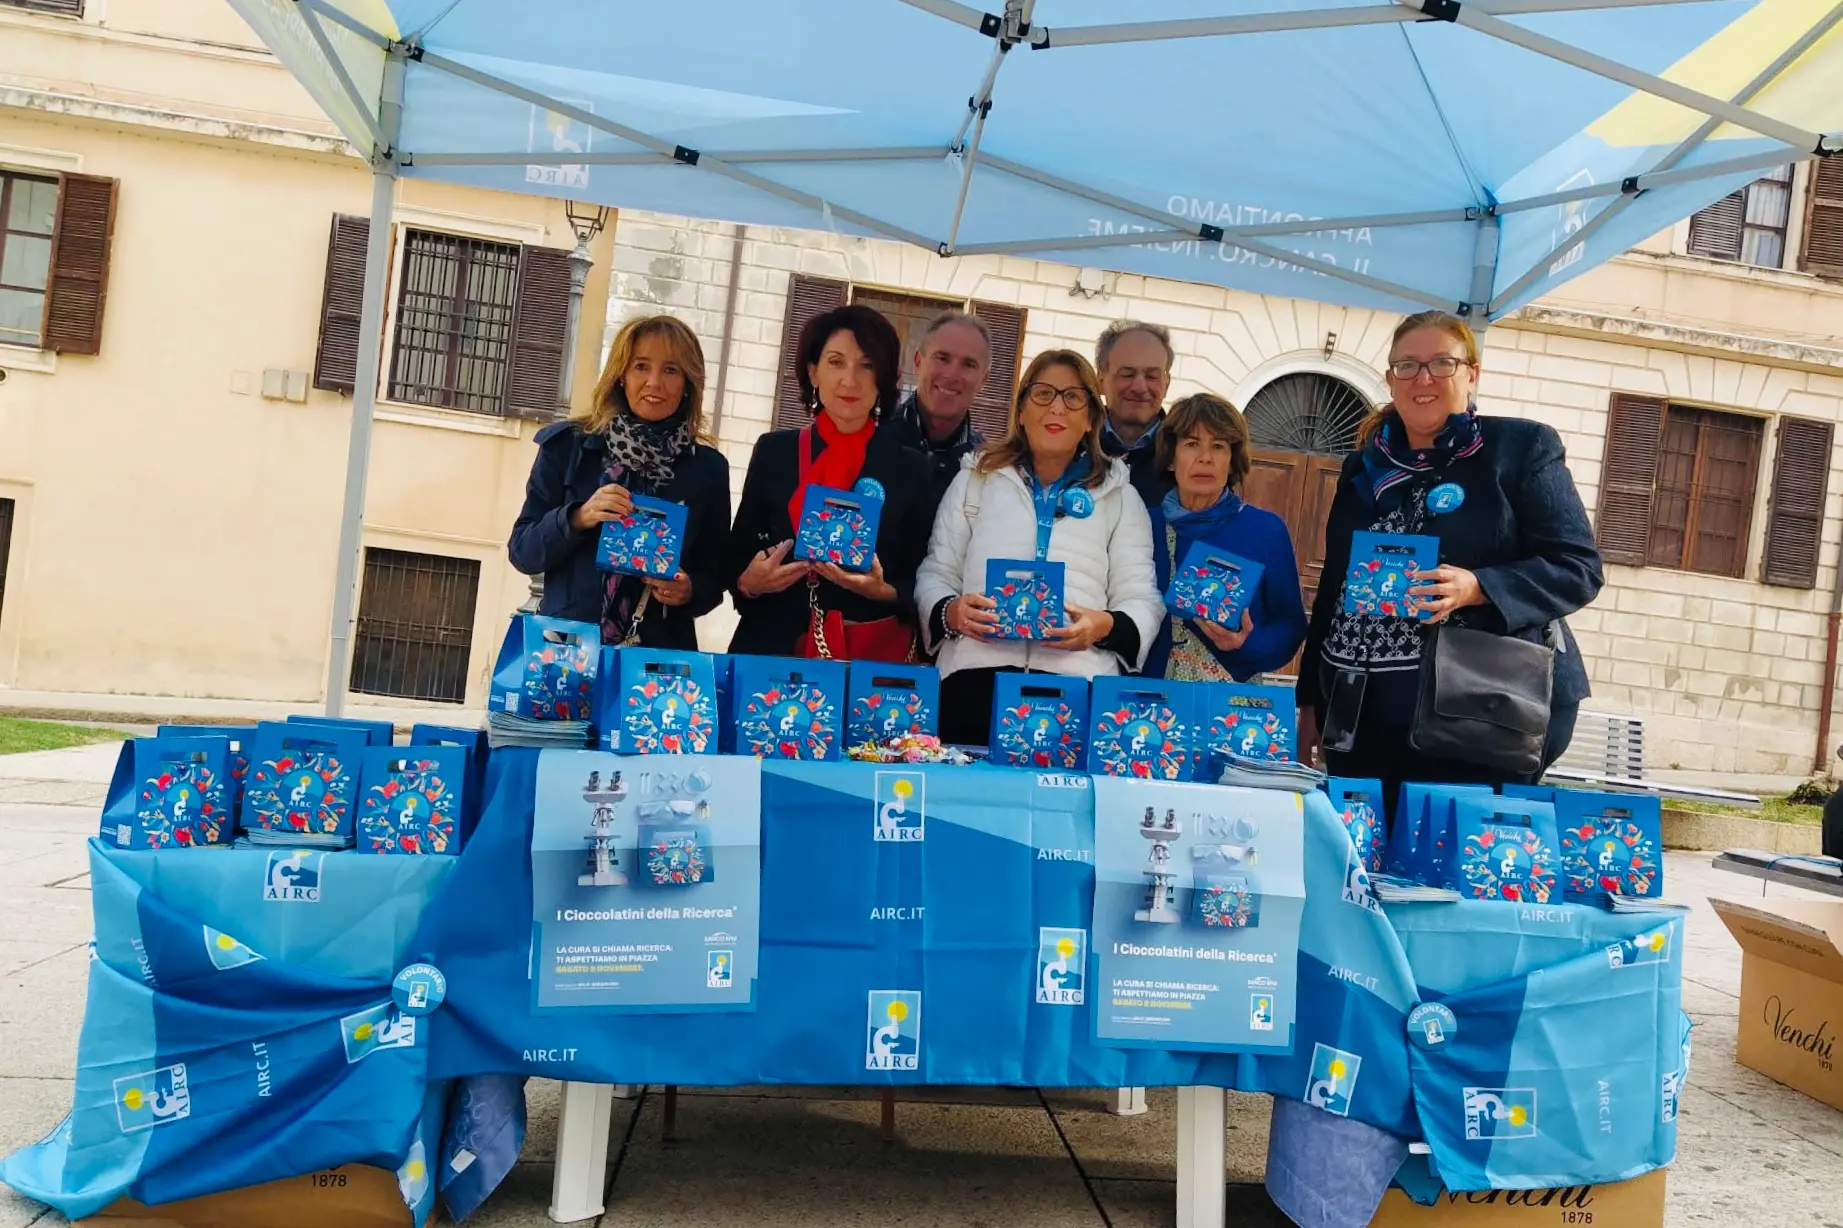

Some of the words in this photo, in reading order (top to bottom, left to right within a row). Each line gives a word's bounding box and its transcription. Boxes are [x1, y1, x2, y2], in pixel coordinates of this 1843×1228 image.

[1041, 774, 1087, 787] AIRC
[289, 800, 312, 808] AIRC
[877, 828, 922, 840] AIRC
[1037, 847, 1090, 862] AIRC.IT
[267, 887, 318, 900] AIRC
[1345, 890, 1377, 911] AIR
[557, 910, 561, 921] I
[564, 907, 644, 921] Cioccolatini
[647, 907, 680, 920] della
[870, 907, 925, 920] AIRC.IT
[1521, 908, 1575, 923] AIRC.IT
[556, 945, 567, 953] LA
[568, 945, 591, 953] CURA
[592, 945, 600, 953] SI
[602, 944, 634, 952] CHIAMA
[1114, 943, 1118, 954] I
[1120, 943, 1193, 959] Cioccolatini
[1196, 949, 1225, 961] della
[556, 956, 564, 964] TI
[565, 955, 617, 963] ASPETTIAMO
[629, 954, 658, 962] PIAZZA
[400, 966, 445, 993] VOLONTARIO
[1113, 979, 1123, 987] LA
[1124, 980, 1145, 988] CURA
[1154, 981, 1185, 989] CHIAMA
[1328, 965, 1379, 989] AIRC.IT
[1040, 991, 1081, 1003] AIRC
[1121, 989, 1169, 999] ASPETTIAMO
[1764, 995, 1835, 1060] Venchi
[523, 1048, 578, 1062] AIRC.IT
[870, 1056, 916, 1068] AIRC
[252, 1041, 272, 1098] AIRC.IT
[173, 1065, 188, 1116] AIRC
[1663, 1077, 1672, 1121] AIRC
[1465, 1090, 1479, 1138] AIRC
[1598, 1080, 1611, 1134] AIRC.IT
[311, 1174, 347, 1188] 1878
[1561, 1212, 1593, 1223] 1878
